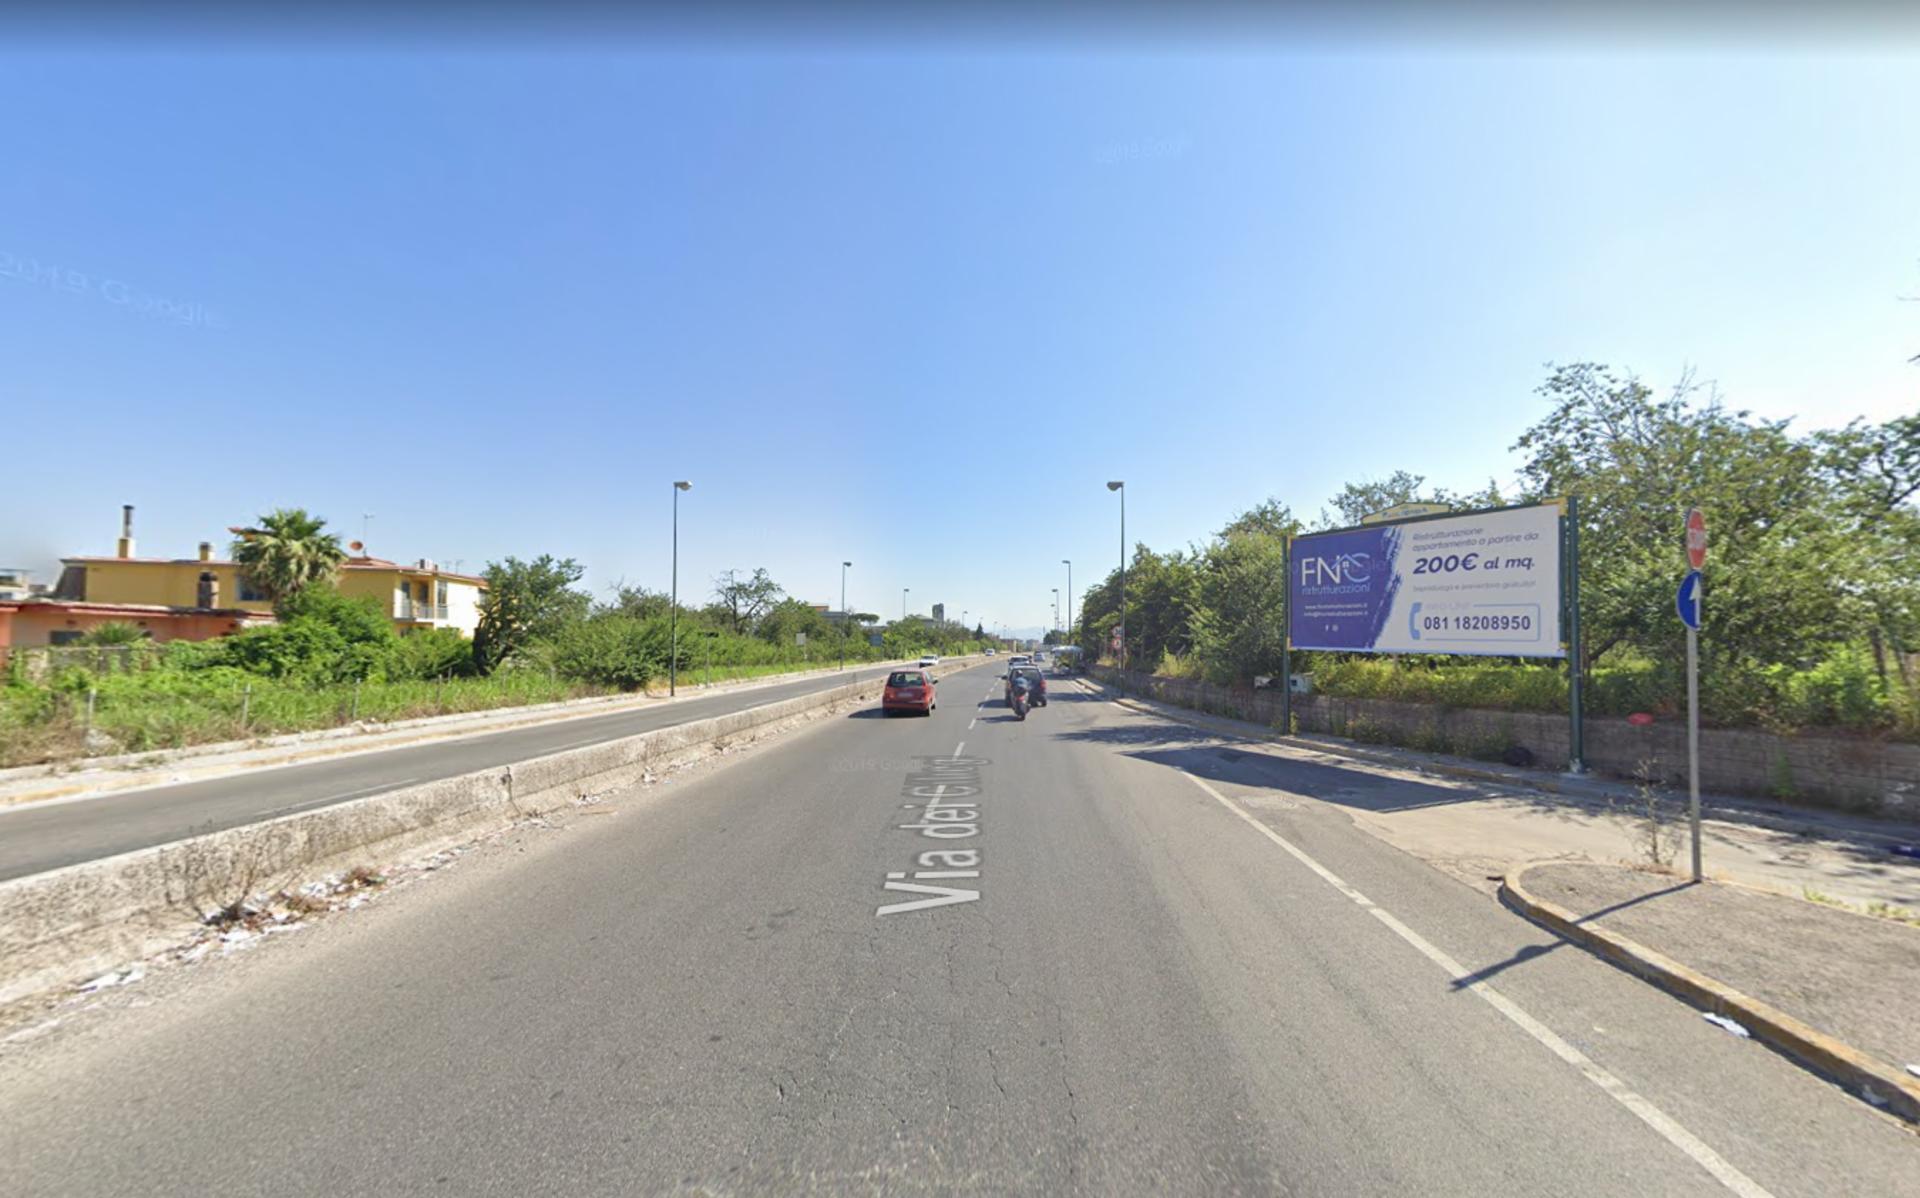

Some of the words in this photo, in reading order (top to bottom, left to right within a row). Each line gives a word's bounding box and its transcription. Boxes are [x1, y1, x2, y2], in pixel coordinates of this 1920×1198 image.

[1413, 552, 1479, 574] 200€
[1484, 556, 1500, 570] al
[1505, 557, 1535, 570] mq.
[1424, 616, 1449, 630] 081
[1454, 615, 1531, 630] 18208950
